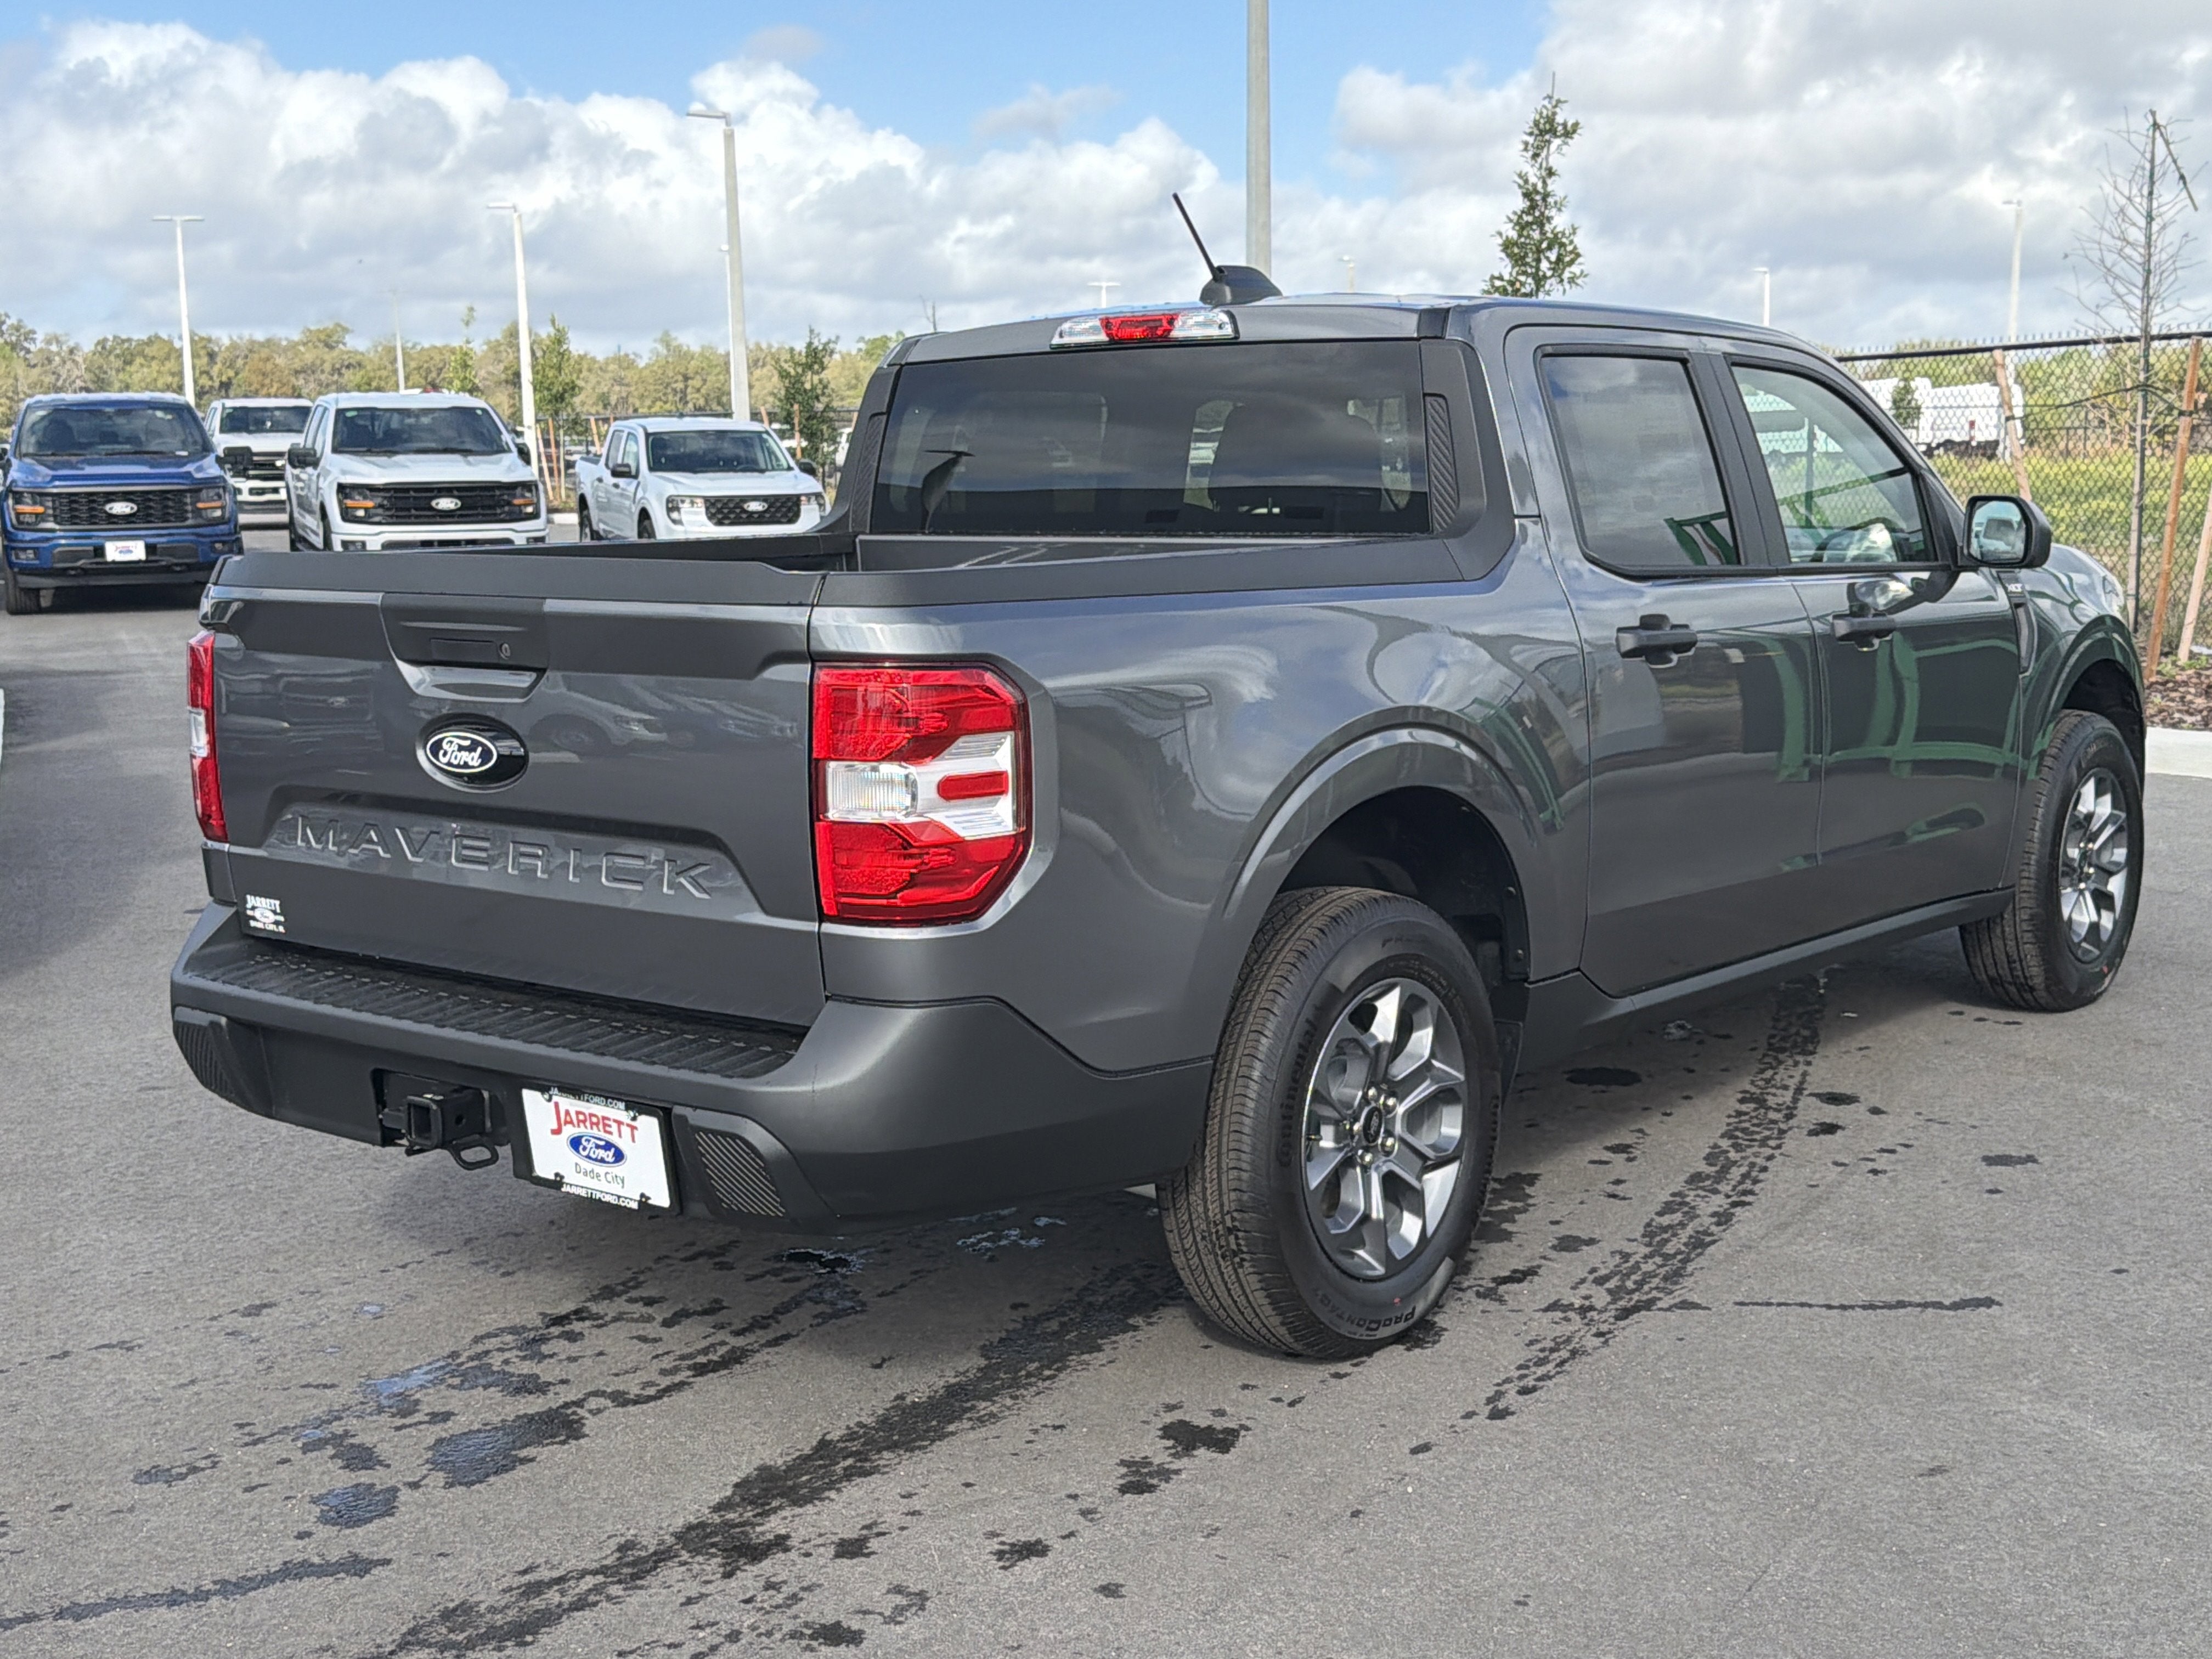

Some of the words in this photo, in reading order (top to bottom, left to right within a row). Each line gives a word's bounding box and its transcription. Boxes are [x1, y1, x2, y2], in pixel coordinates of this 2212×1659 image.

[439, 737, 482, 766] Ford
[297, 815, 713, 900] MAVERICK
[550, 1101, 639, 1143] JARRETT
[579, 1136, 615, 1164] Ford
[574, 1163, 602, 1182] Dade
[605, 1172, 625, 1189] City
[561, 1183, 639, 1210] JARRETTFORD.COM
